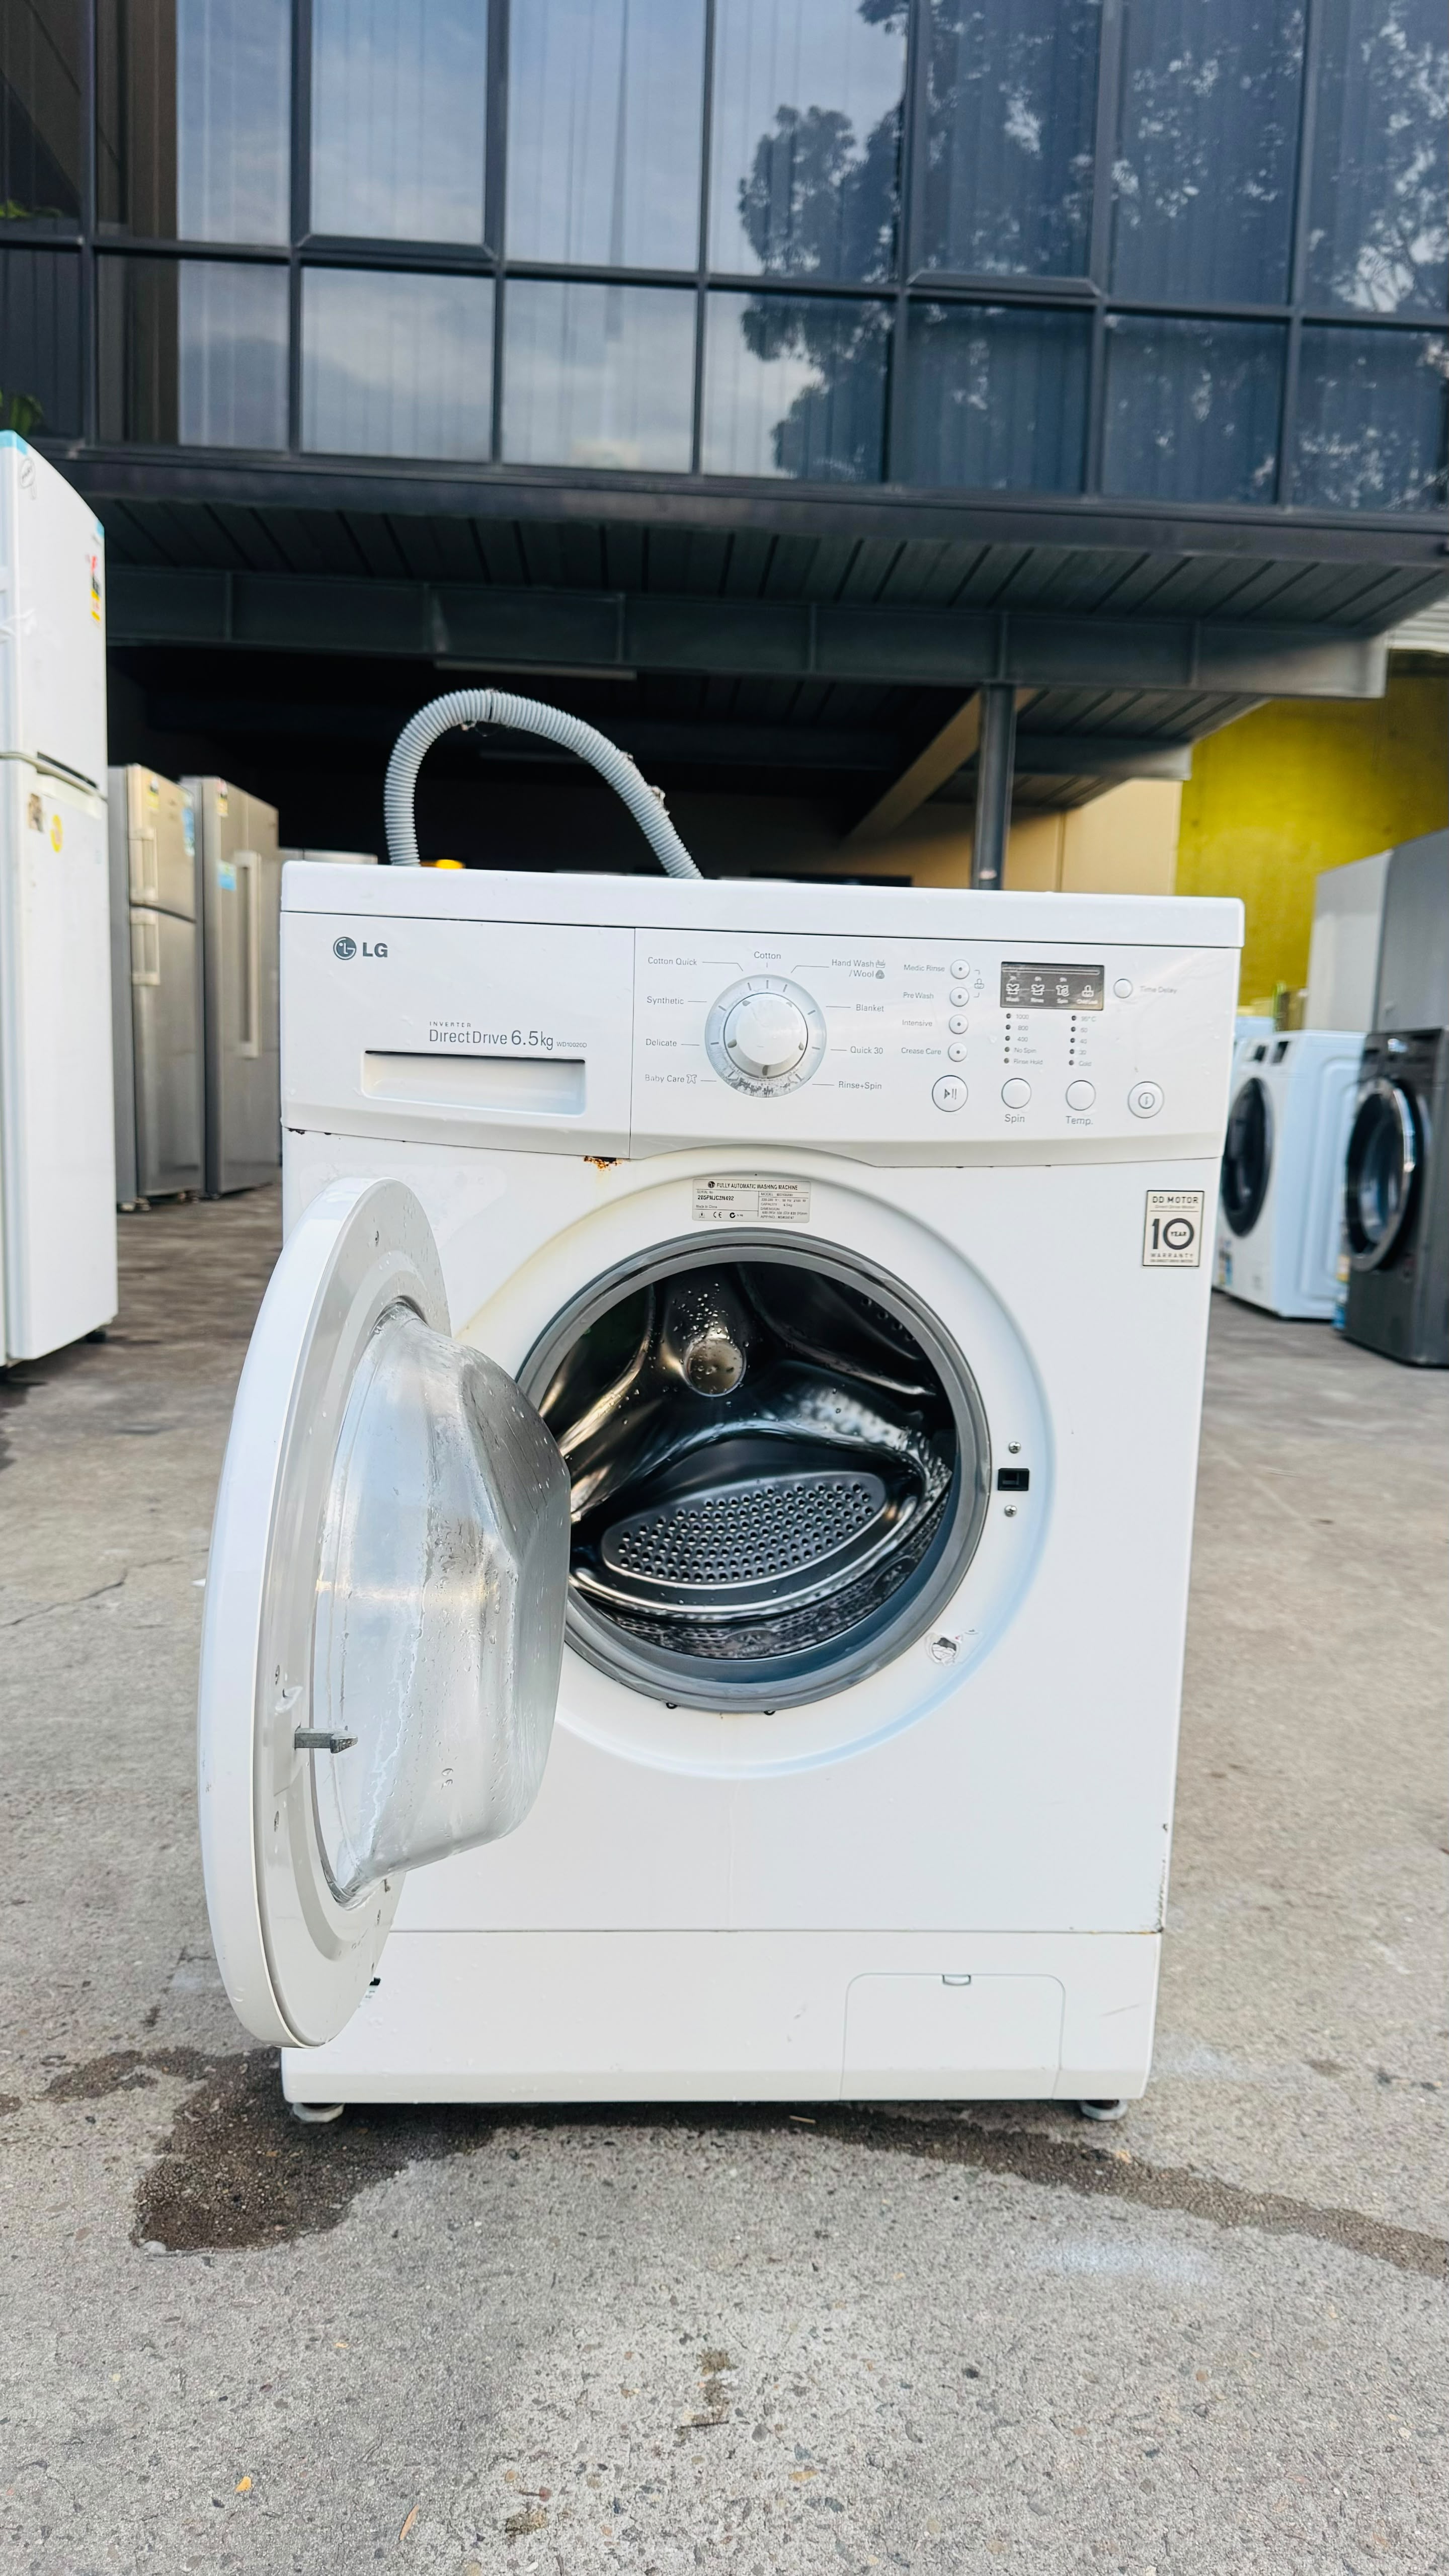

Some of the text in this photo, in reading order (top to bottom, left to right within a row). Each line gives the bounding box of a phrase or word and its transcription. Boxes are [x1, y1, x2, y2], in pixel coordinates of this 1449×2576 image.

[363, 942, 388, 958] LG
[754, 951, 781, 959] Cotton
[676, 957, 697, 965] Quick
[853, 959, 874, 968] Wash
[647, 996, 684, 1005] Synthetic
[856, 1004, 884, 1012] Blanket
[511, 1030, 553, 1051] 6.5kg
[646, 1038, 677, 1046] Delicate
[850, 1045, 883, 1055] Quick 30
[645, 1074, 664, 1083] Baby
[839, 1081, 882, 1090] Rinse+Spin
[1004, 1113, 1025, 1124] Spin
[1066, 1115, 1093, 1126] Temp.
[1152, 1218, 1194, 1250] 10
